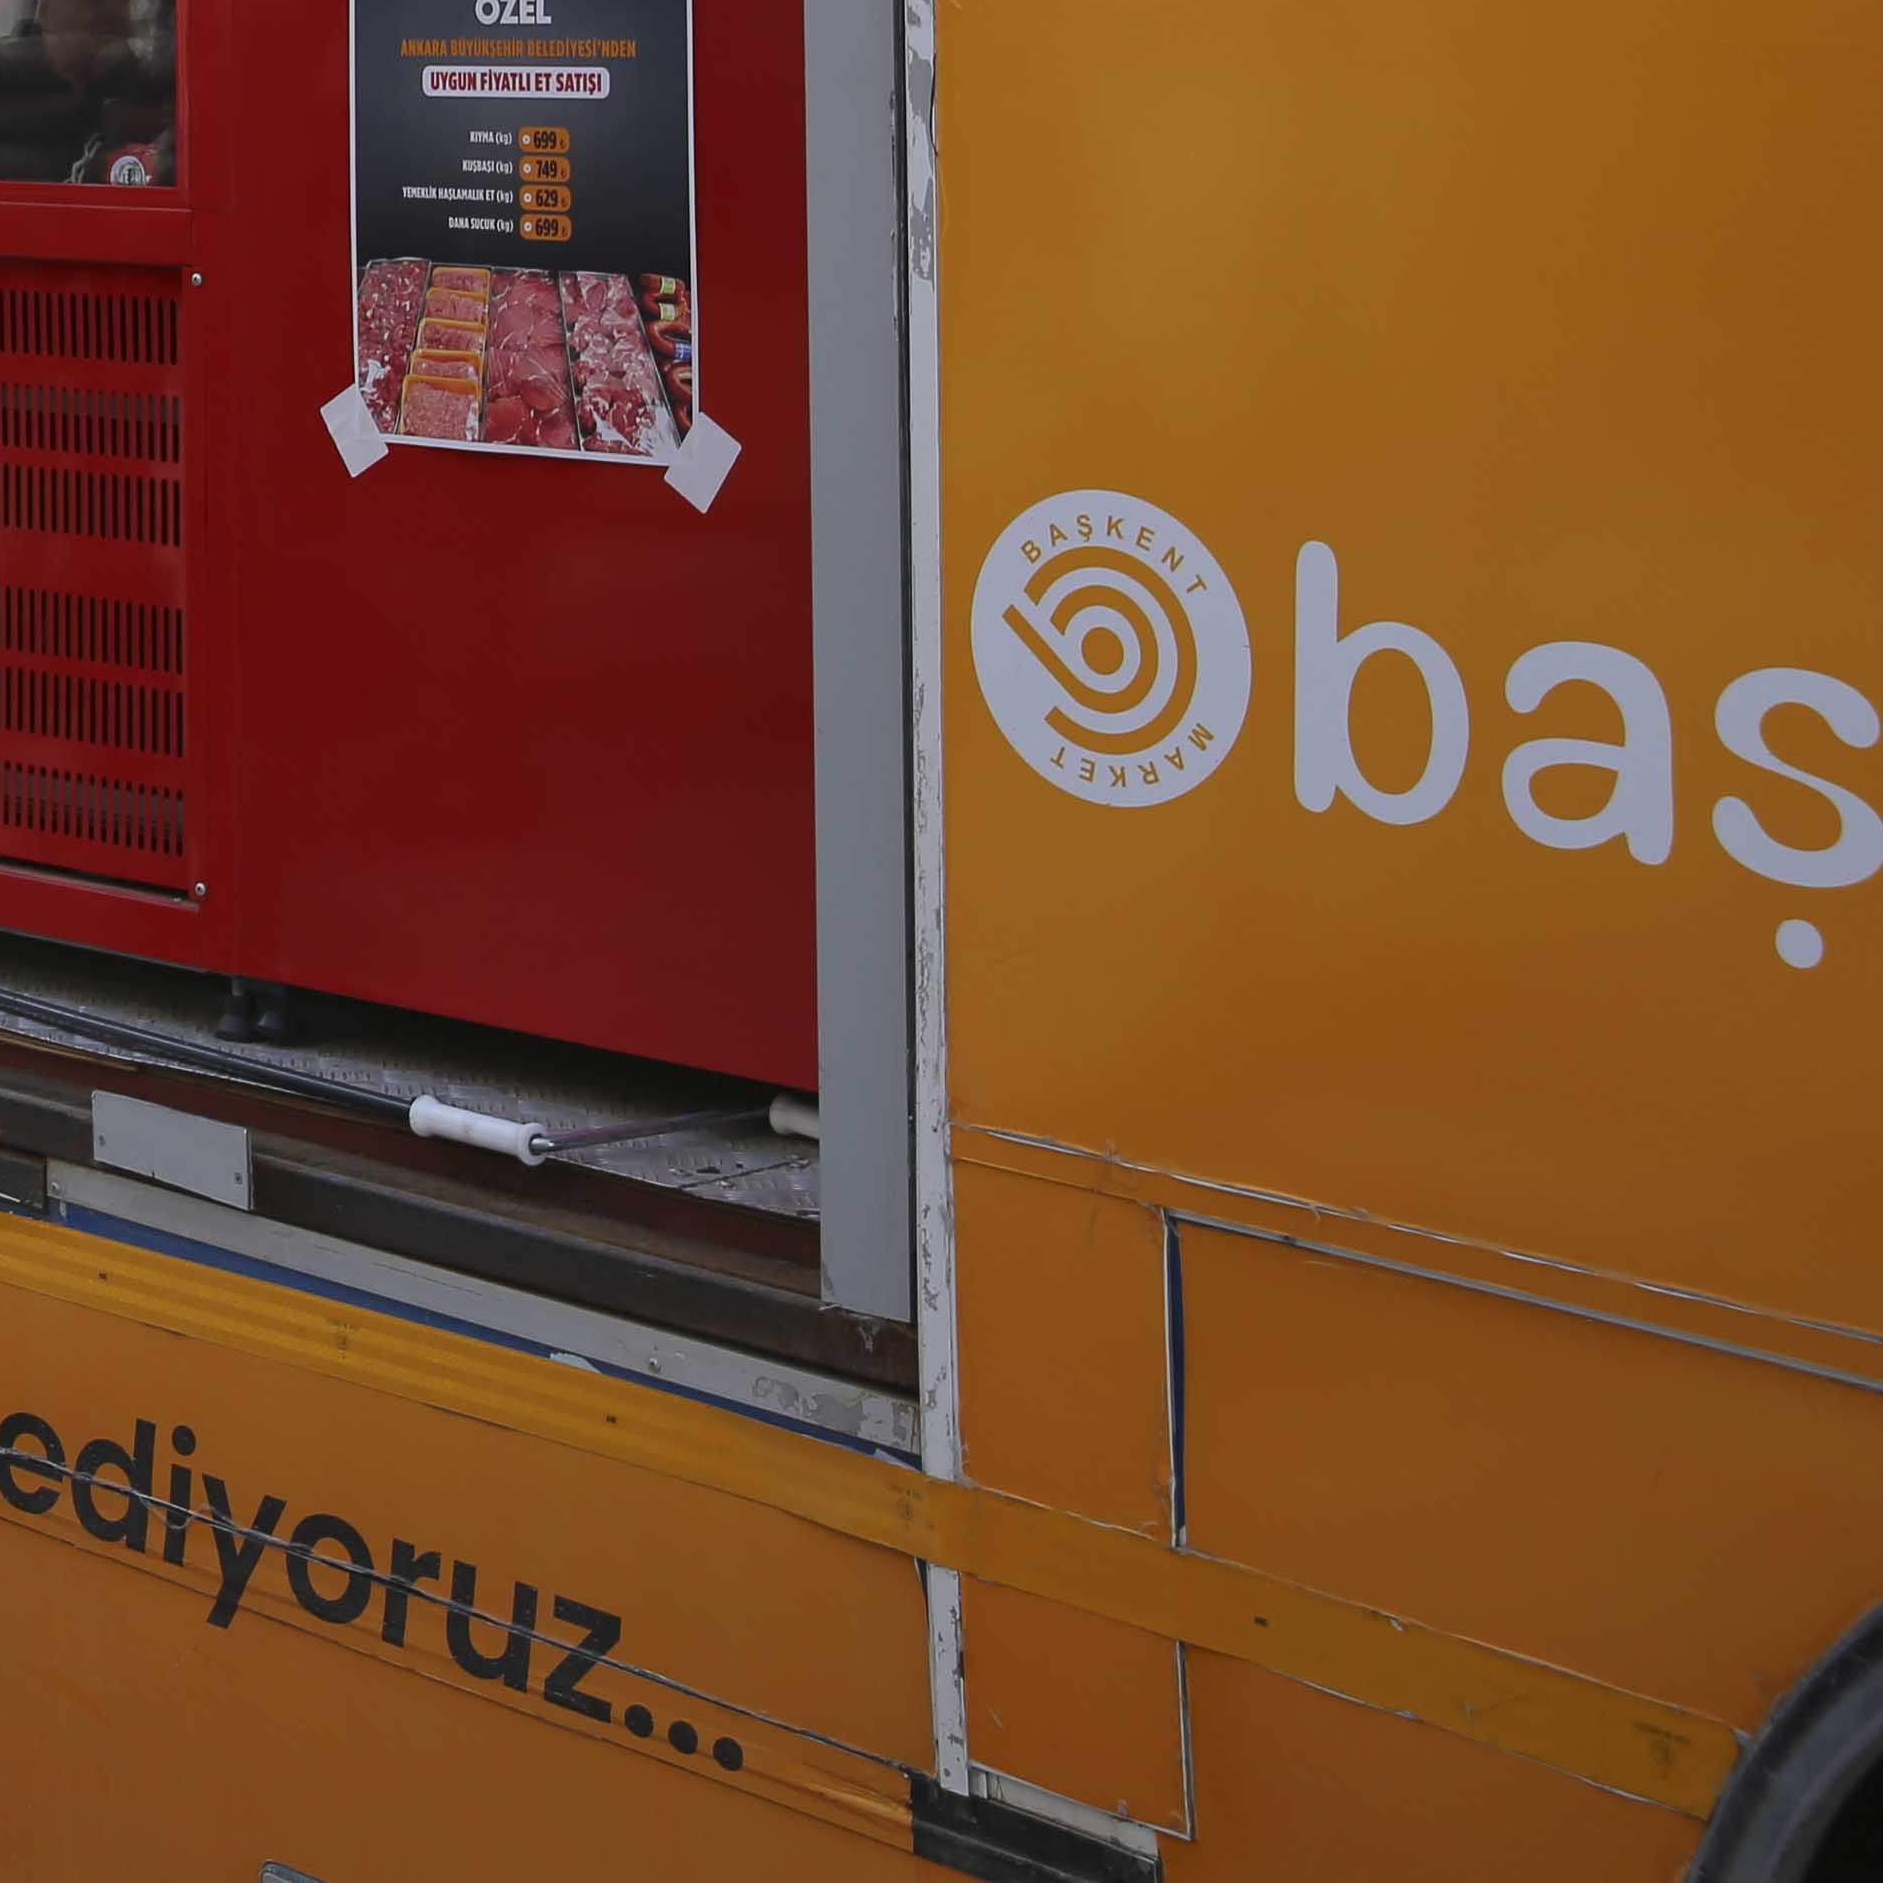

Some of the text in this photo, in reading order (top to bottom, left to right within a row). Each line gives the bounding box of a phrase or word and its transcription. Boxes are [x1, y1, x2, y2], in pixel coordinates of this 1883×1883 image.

[400, 38, 447, 58] ANKARA
[449, 37, 523, 59] BÜYÜKŞEHİR
[430, 68, 603, 96] UYGUN FİYATLI ET SATIŞI
[469, 130, 495, 144] KIYMA
[495, 131, 513, 146] (kg)
[533, 130, 557, 150] 699
[462, 159, 495, 174] KUŞBAŞI
[495, 160, 513, 175] (kg)
[535, 160, 558, 179] 749
[485, 189, 496, 202] ET
[496, 189, 514, 204] (kg)
[535, 189, 558, 208] 629
[470, 217, 496, 231] SUCUK
[496, 219, 514, 234] (kg)
[535, 218, 559, 237] 699
[1019, 514, 1208, 597] BAŞKENT
[1048, 722, 1216, 789] MARKET
[1294, 539, 1883, 970] baş
